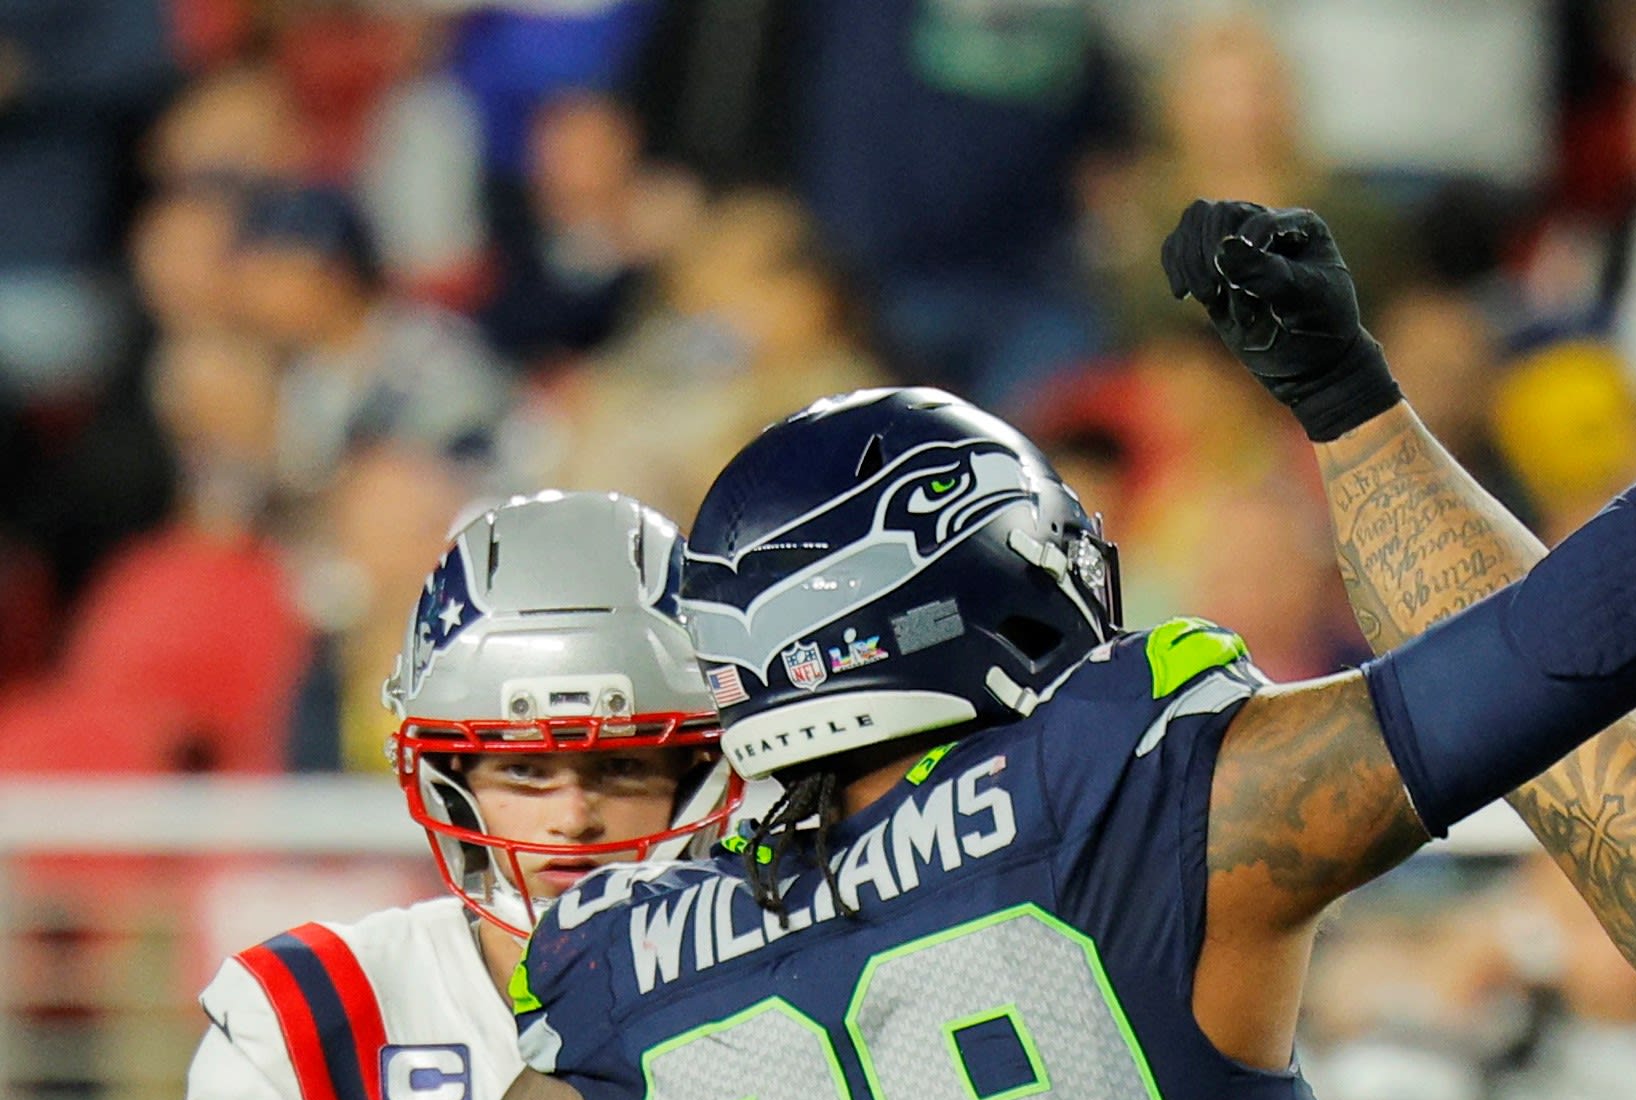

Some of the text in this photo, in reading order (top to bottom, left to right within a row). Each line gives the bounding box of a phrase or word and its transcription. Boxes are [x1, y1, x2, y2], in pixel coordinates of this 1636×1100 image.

[791, 661, 824, 683] NFL
[733, 714, 874, 762] SEATTLE
[629, 754, 1018, 995] WILLIAMS
